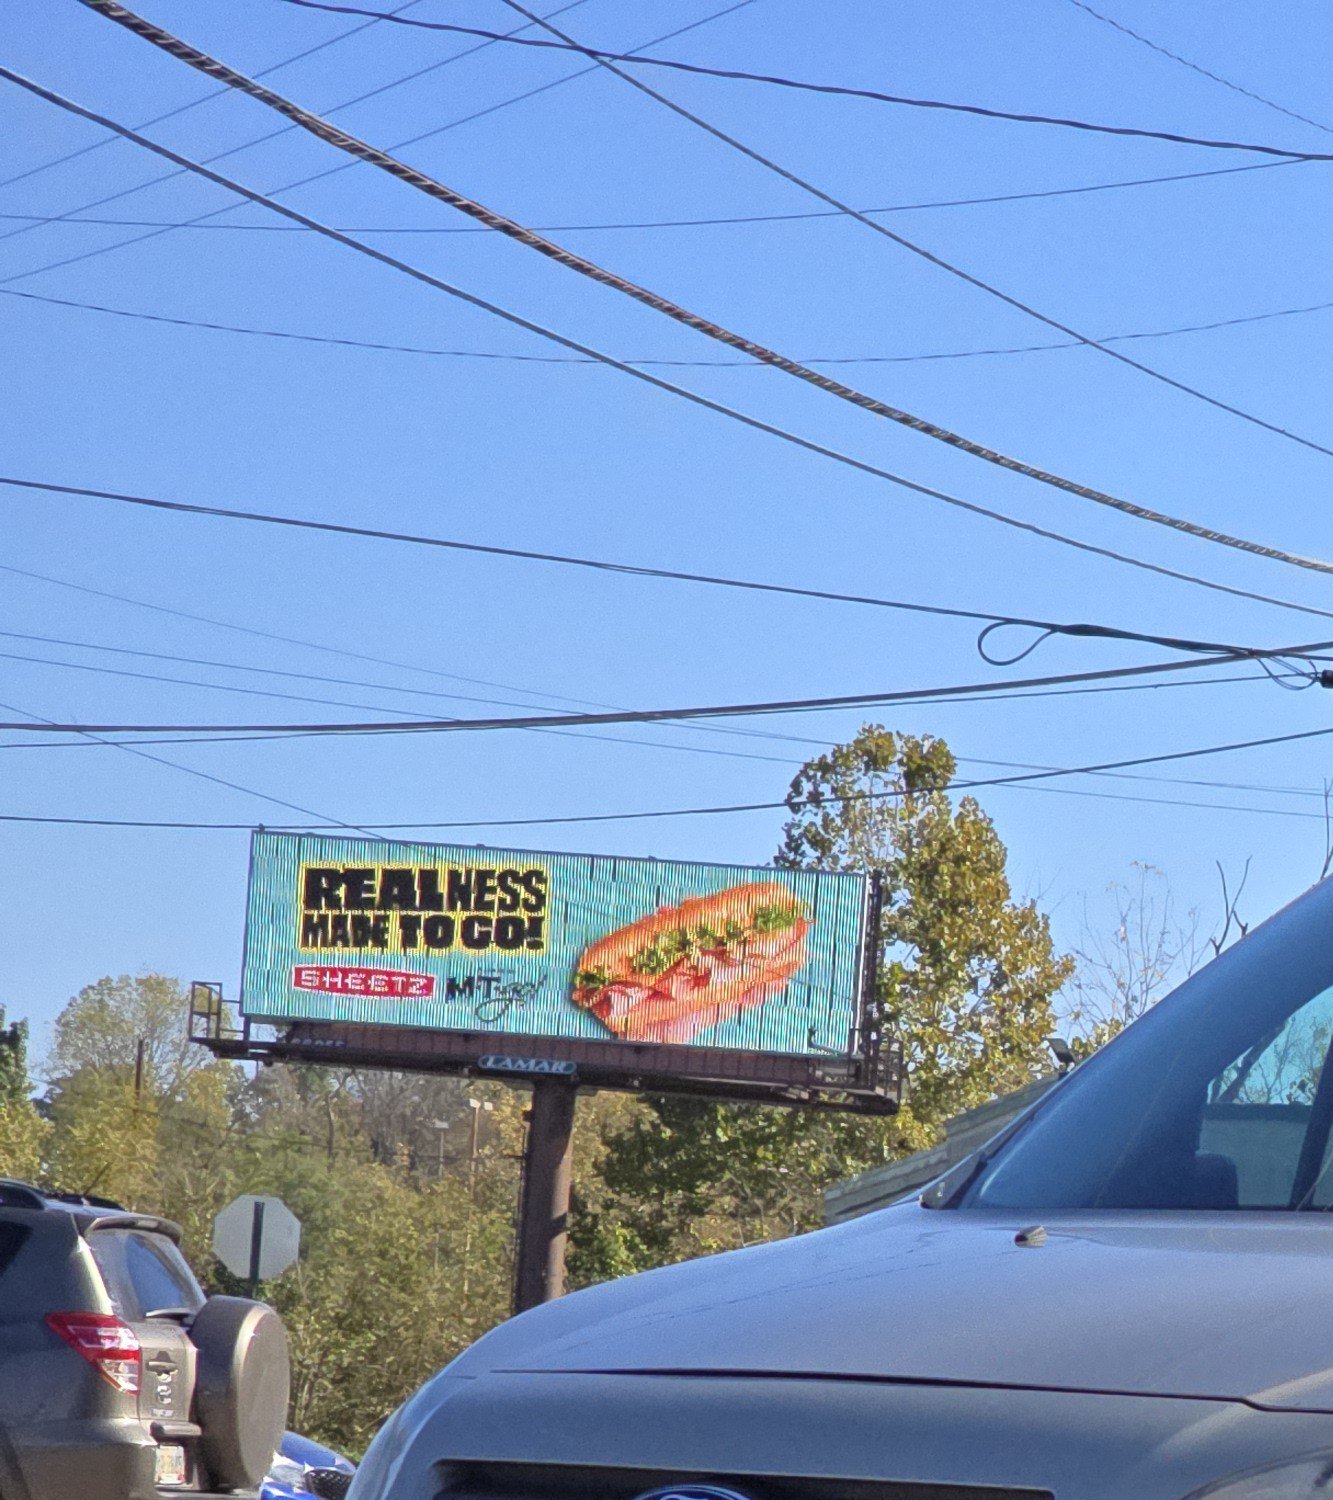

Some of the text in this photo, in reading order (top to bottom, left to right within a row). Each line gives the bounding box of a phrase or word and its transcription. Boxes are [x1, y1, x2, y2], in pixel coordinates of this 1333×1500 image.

[303, 867, 547, 913] REALNESS
[301, 913, 545, 951] MADE TO GO!
[300, 969, 429, 996] SHEETZ
[486, 1055, 567, 1073] LAMAR
